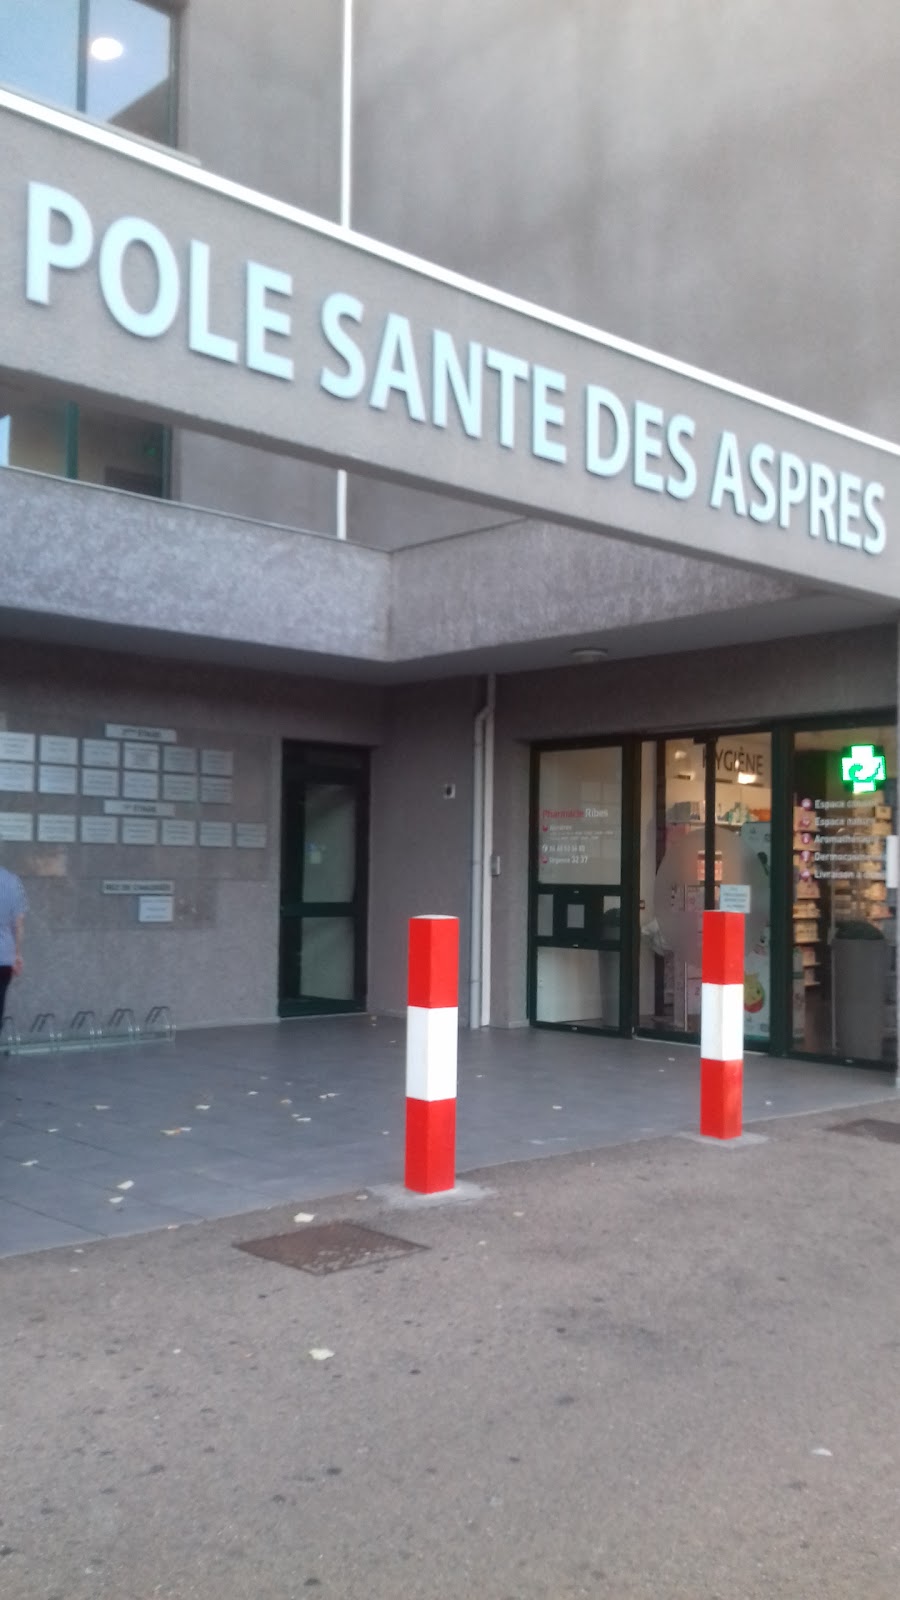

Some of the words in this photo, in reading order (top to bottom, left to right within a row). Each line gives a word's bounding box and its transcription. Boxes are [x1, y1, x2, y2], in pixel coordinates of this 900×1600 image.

[25, 181, 295, 381] POLE
[320, 293, 568, 464] SANTE
[585, 384, 698, 500] DES
[709, 430, 887, 556] ASPRES
[703, 746, 763, 775] YGIÈNE
[585, 808, 609, 818] Ribes
